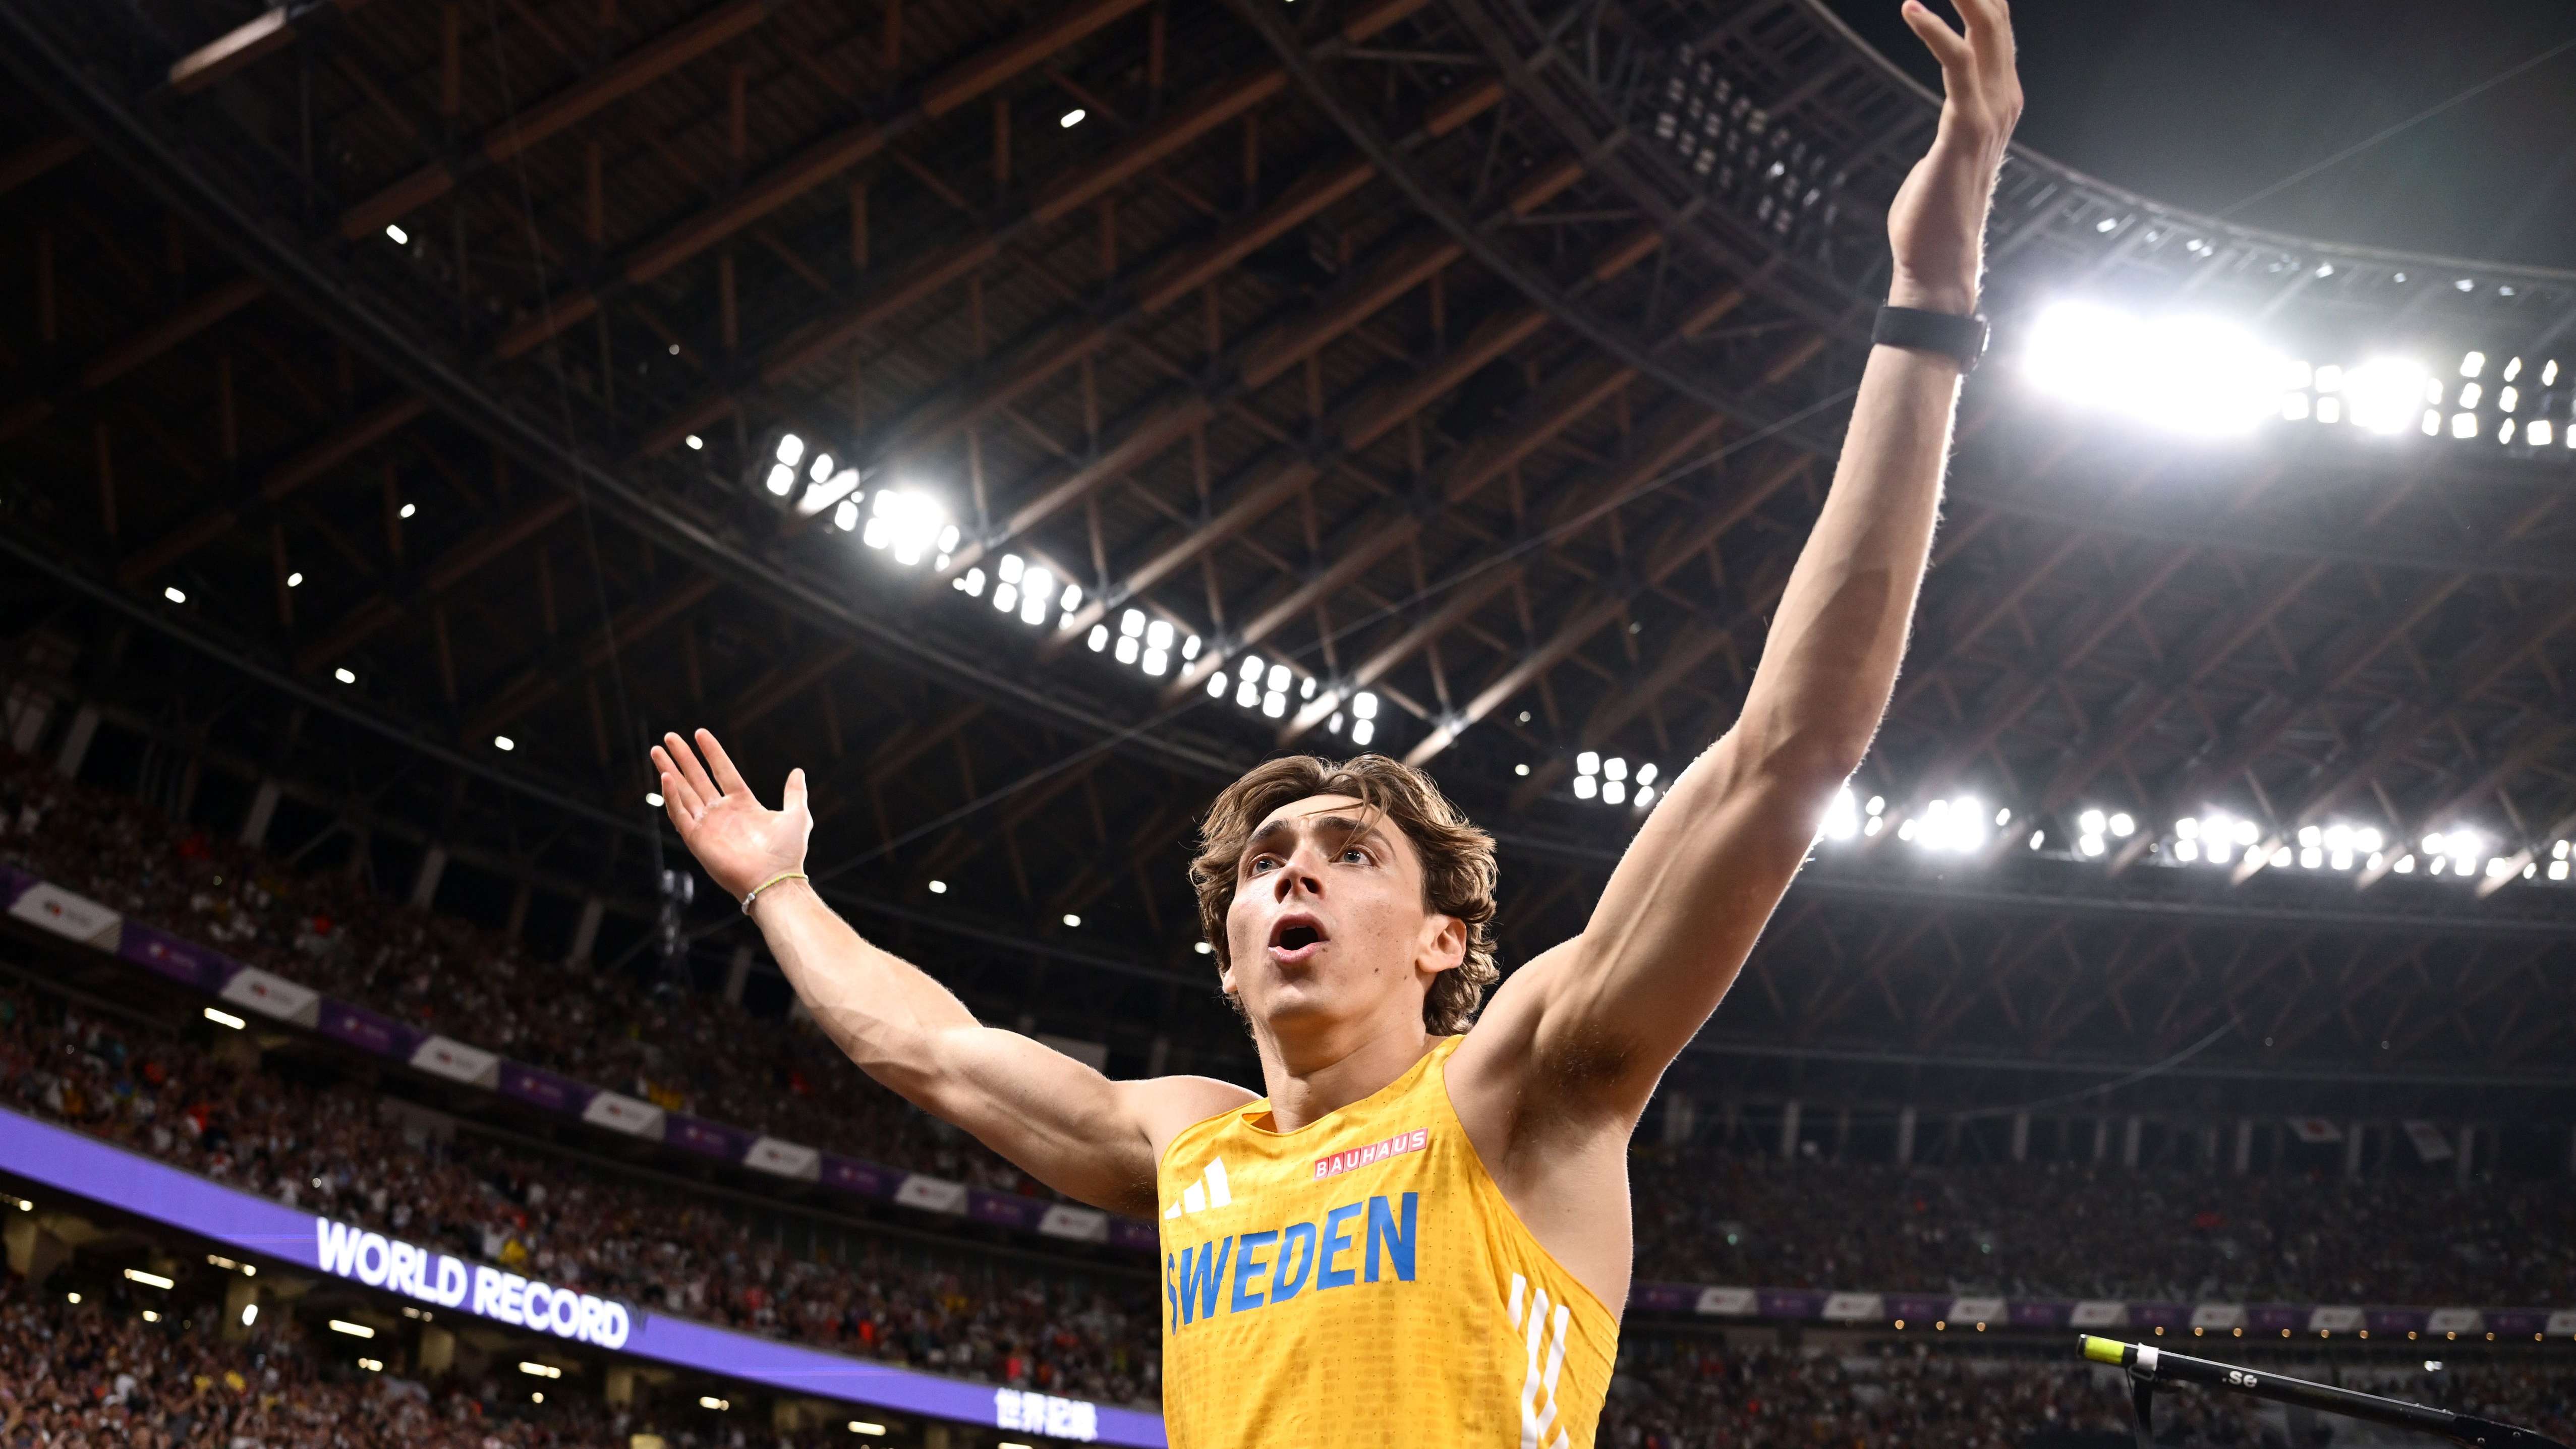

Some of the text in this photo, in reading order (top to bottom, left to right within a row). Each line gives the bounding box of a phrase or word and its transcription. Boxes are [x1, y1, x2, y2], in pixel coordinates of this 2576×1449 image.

[1316, 1131, 1425, 1178] BAUHAUS
[317, 1216, 629, 1350] WORLD RECORD
[1167, 1191, 1418, 1336] SWEDEN
